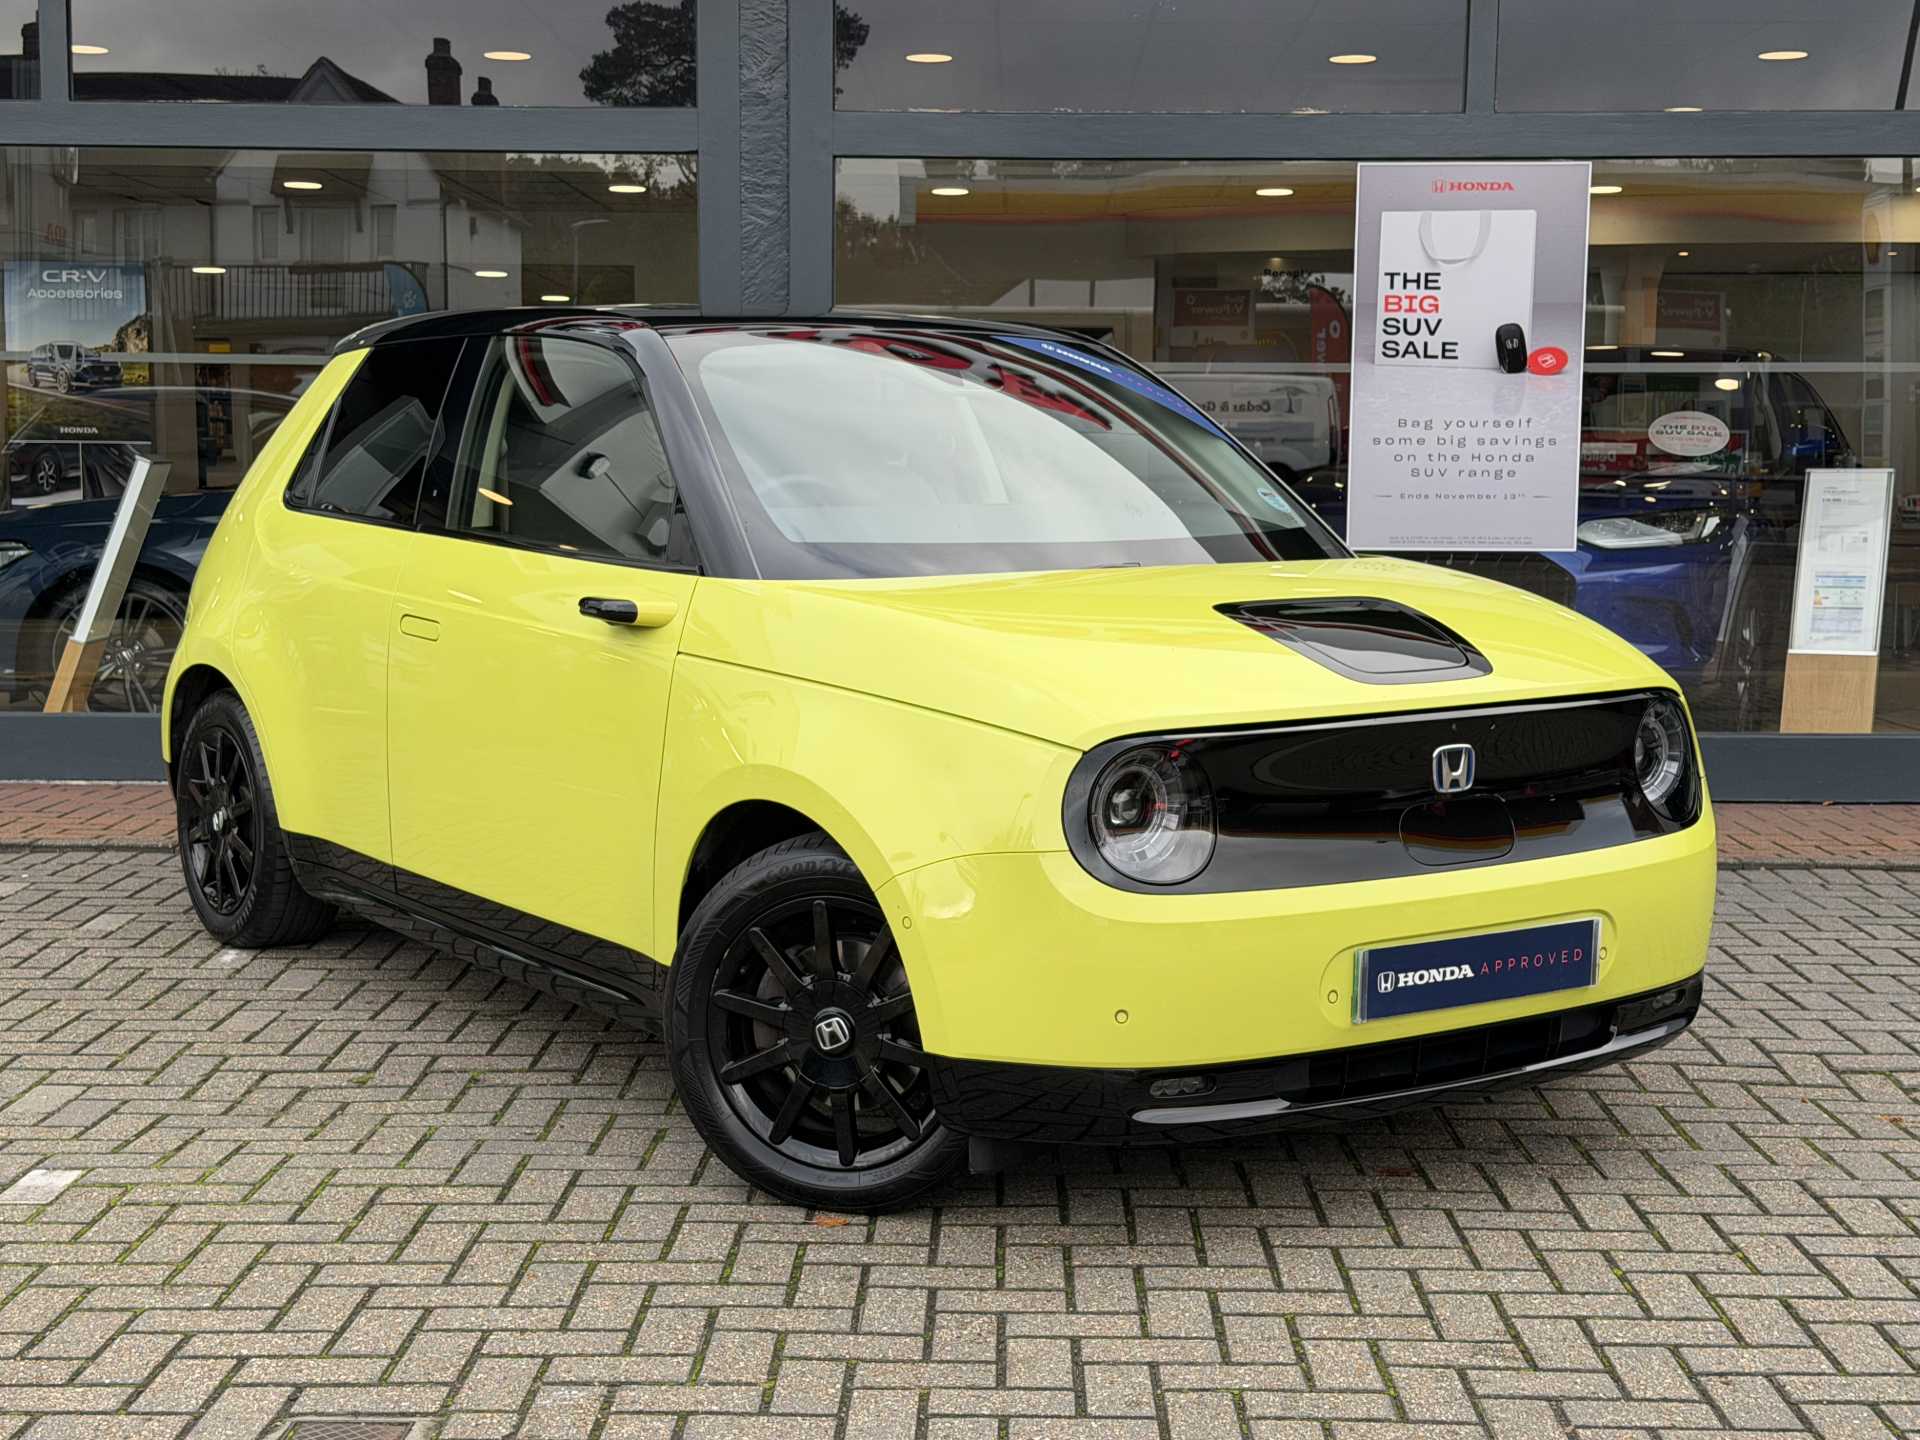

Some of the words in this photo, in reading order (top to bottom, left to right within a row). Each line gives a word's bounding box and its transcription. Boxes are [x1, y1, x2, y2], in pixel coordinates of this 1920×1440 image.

[1449, 181, 1515, 192] HONDA
[42, 269, 107, 283] CR-V
[1384, 272, 1442, 291] THE
[27, 287, 123, 300] Accessories
[1383, 294, 1440, 314] BIG
[1382, 318, 1443, 337] SUV
[1381, 340, 1459, 360] SALE
[59, 425, 99, 435] HONDA
[1397, 418, 1434, 431] Bag
[1443, 417, 1533, 431] yourself
[1372, 436, 1426, 446] some
[1436, 435, 1467, 449] big
[1476, 435, 1558, 449] savings
[1393, 453, 1417, 463] on
[1427, 452, 1461, 463] the
[1471, 452, 1536, 463] Honda
[1410, 468, 1448, 478] SUV
[1458, 468, 1517, 481] range
[1399, 492, 1430, 500] Ends
[1435, 492, 1497, 500] November
[1397, 963, 1475, 989] HONDA
[1479, 946, 1584, 976] APPROVED
